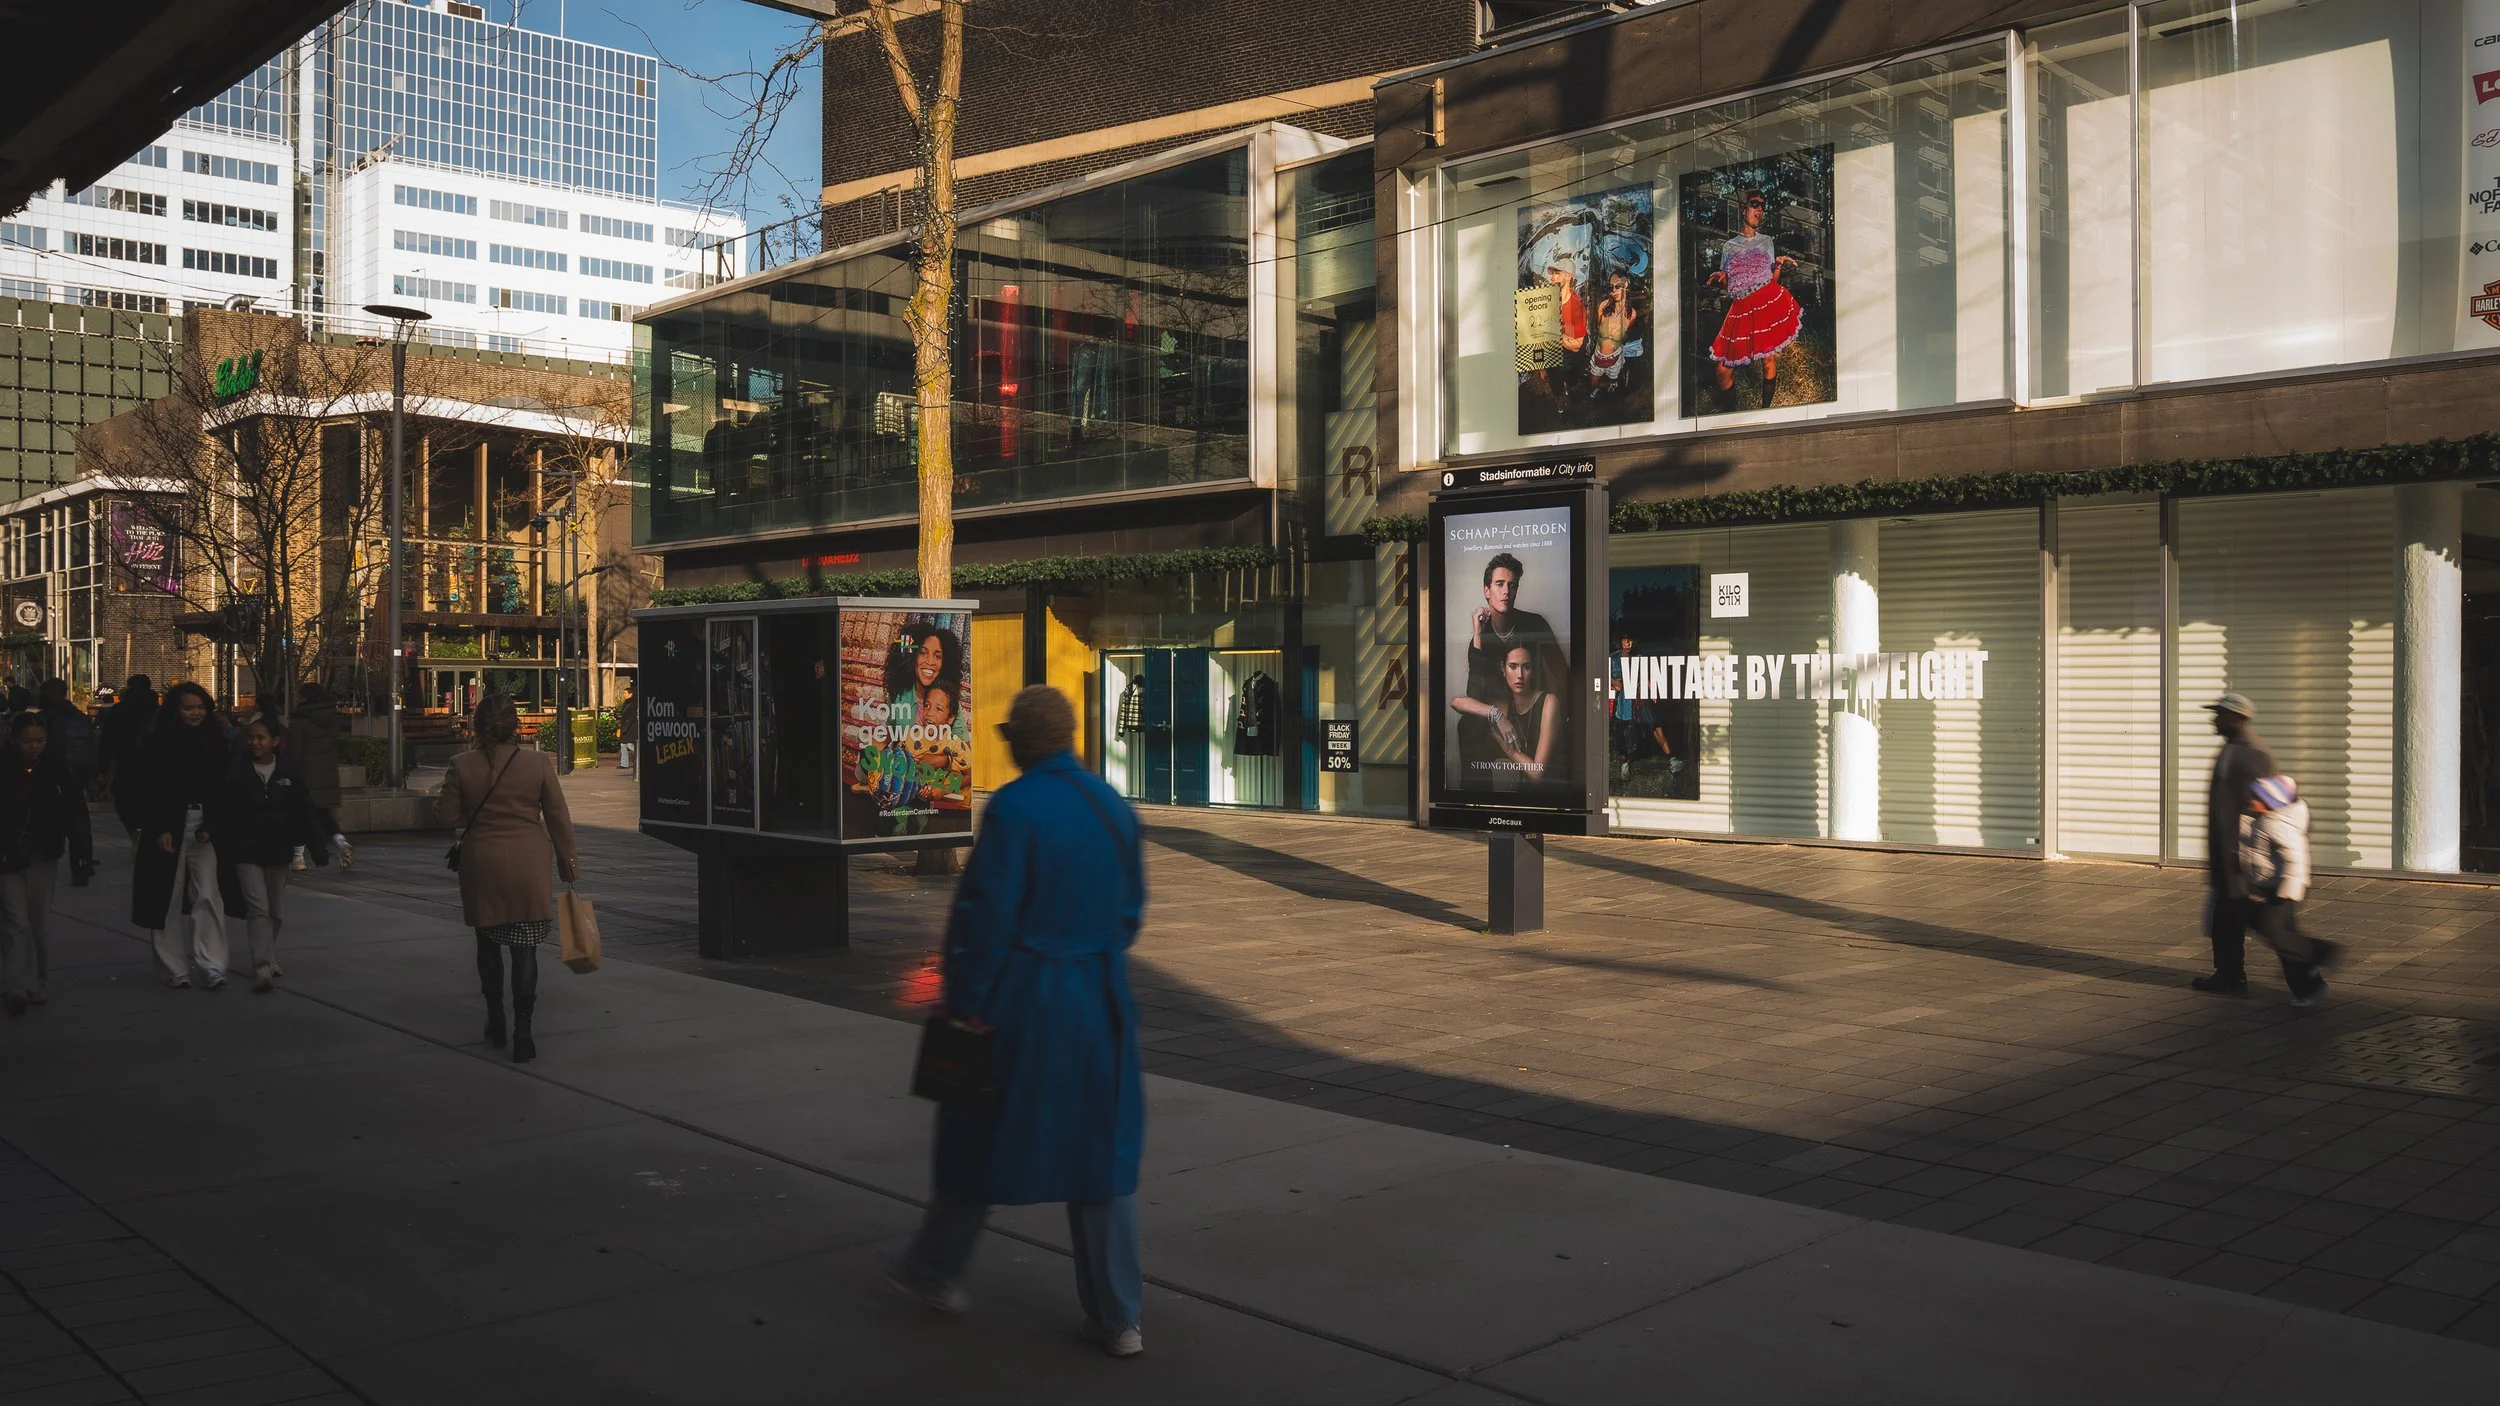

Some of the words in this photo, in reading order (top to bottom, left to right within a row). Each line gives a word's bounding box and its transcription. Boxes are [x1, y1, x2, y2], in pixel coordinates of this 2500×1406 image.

[1525, 294, 1552, 305] opening
[2475, 298, 2500, 312] HARLE
[1528, 303, 1548, 312] doors
[1342, 445, 1374, 499] R
[1480, 466, 1551, 482] Stadsinformatie
[1558, 463, 1576, 476] City
[1577, 461, 1594, 473] info
[1718, 584, 1741, 595] KILO
[1620, 654, 1738, 700] VINTAGE
[1746, 653, 1786, 700] BY
[1790, 653, 1850, 700] THE
[1854, 650, 1989, 700] WEIGHT
[647, 696, 675, 718] Kom
[859, 697, 912, 720] Kom
[647, 721, 700, 742] gewoon.
[1328, 724, 1351, 732] BLACK
[859, 724, 958, 749] gewoon.
[1328, 731, 1351, 739] FRIDAY
[655, 735, 695, 765] LEREN
[1327, 756, 1352, 769] 50%
[1470, 760, 1502, 770] STRONG
[1502, 761, 1545, 772] TOGETHER
[879, 808, 939, 817] #RotterdamCentrum
[1488, 817, 1523, 827] JCDecaux
